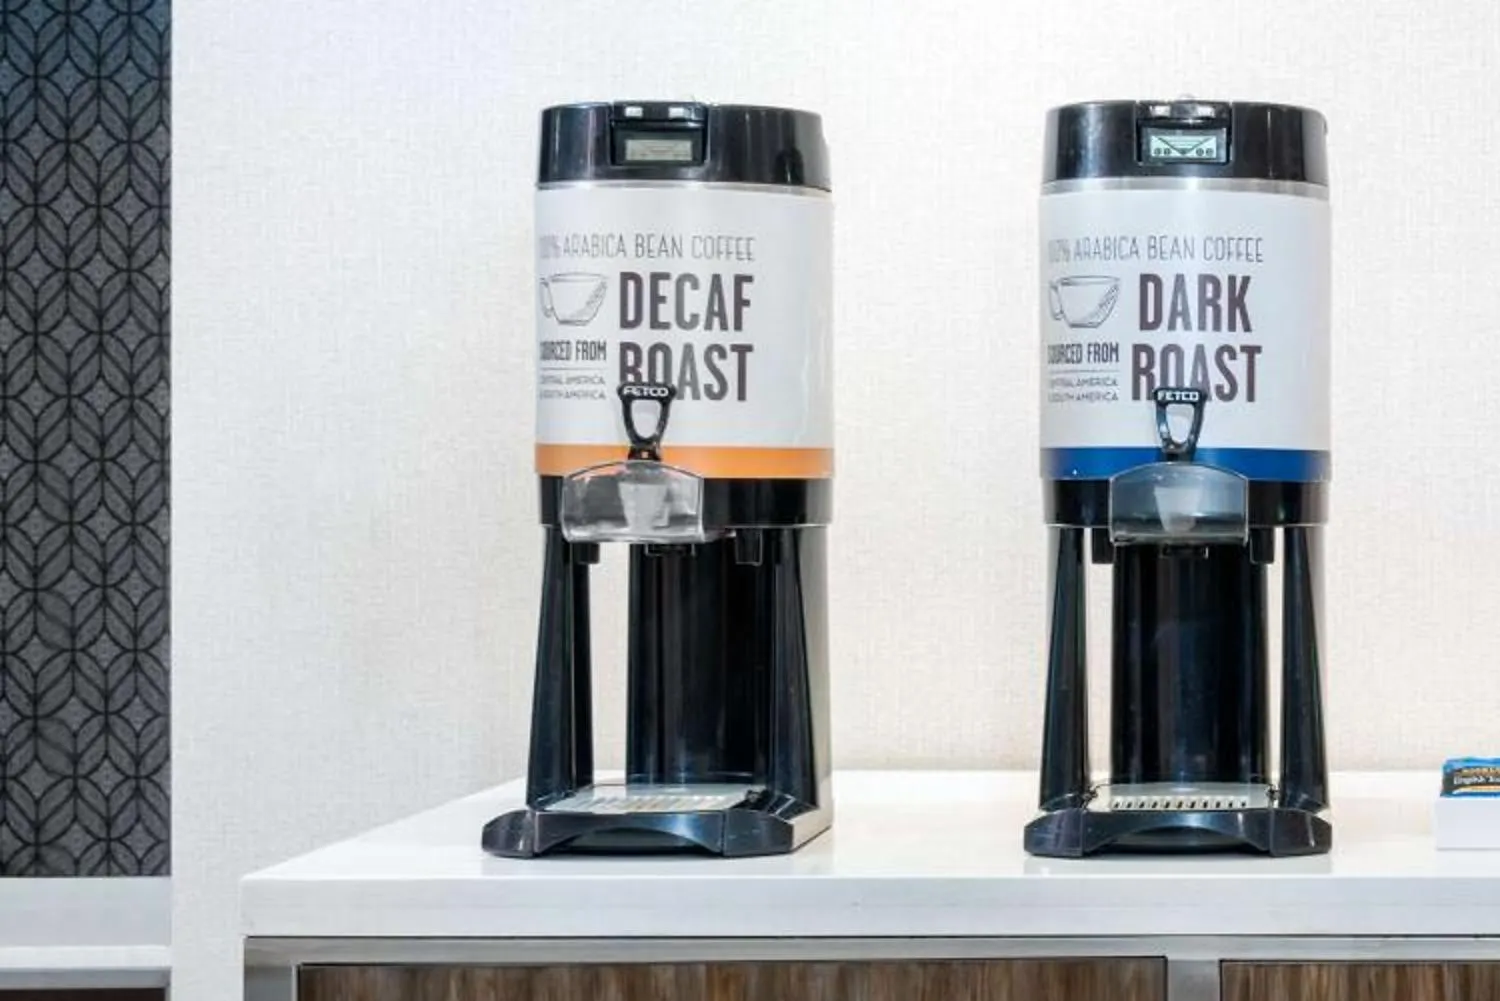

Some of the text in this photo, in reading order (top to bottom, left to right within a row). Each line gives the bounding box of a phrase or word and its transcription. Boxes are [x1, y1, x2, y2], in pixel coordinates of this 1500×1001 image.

[563, 233, 627, 259] ARABICA
[635, 233, 683, 258] BEAN
[691, 235, 755, 261] COFFEE
[1074, 236, 1141, 261] ARABICA
[1147, 235, 1195, 261] BEAN
[1203, 237, 1263, 263] COFFEE
[619, 271, 754, 332] DECAF
[1139, 273, 1252, 333] DARK
[575, 339, 607, 361] FROM
[619, 341, 754, 401] ROAST
[1087, 341, 1119, 363] FROM
[1131, 343, 1263, 402] ROAST
